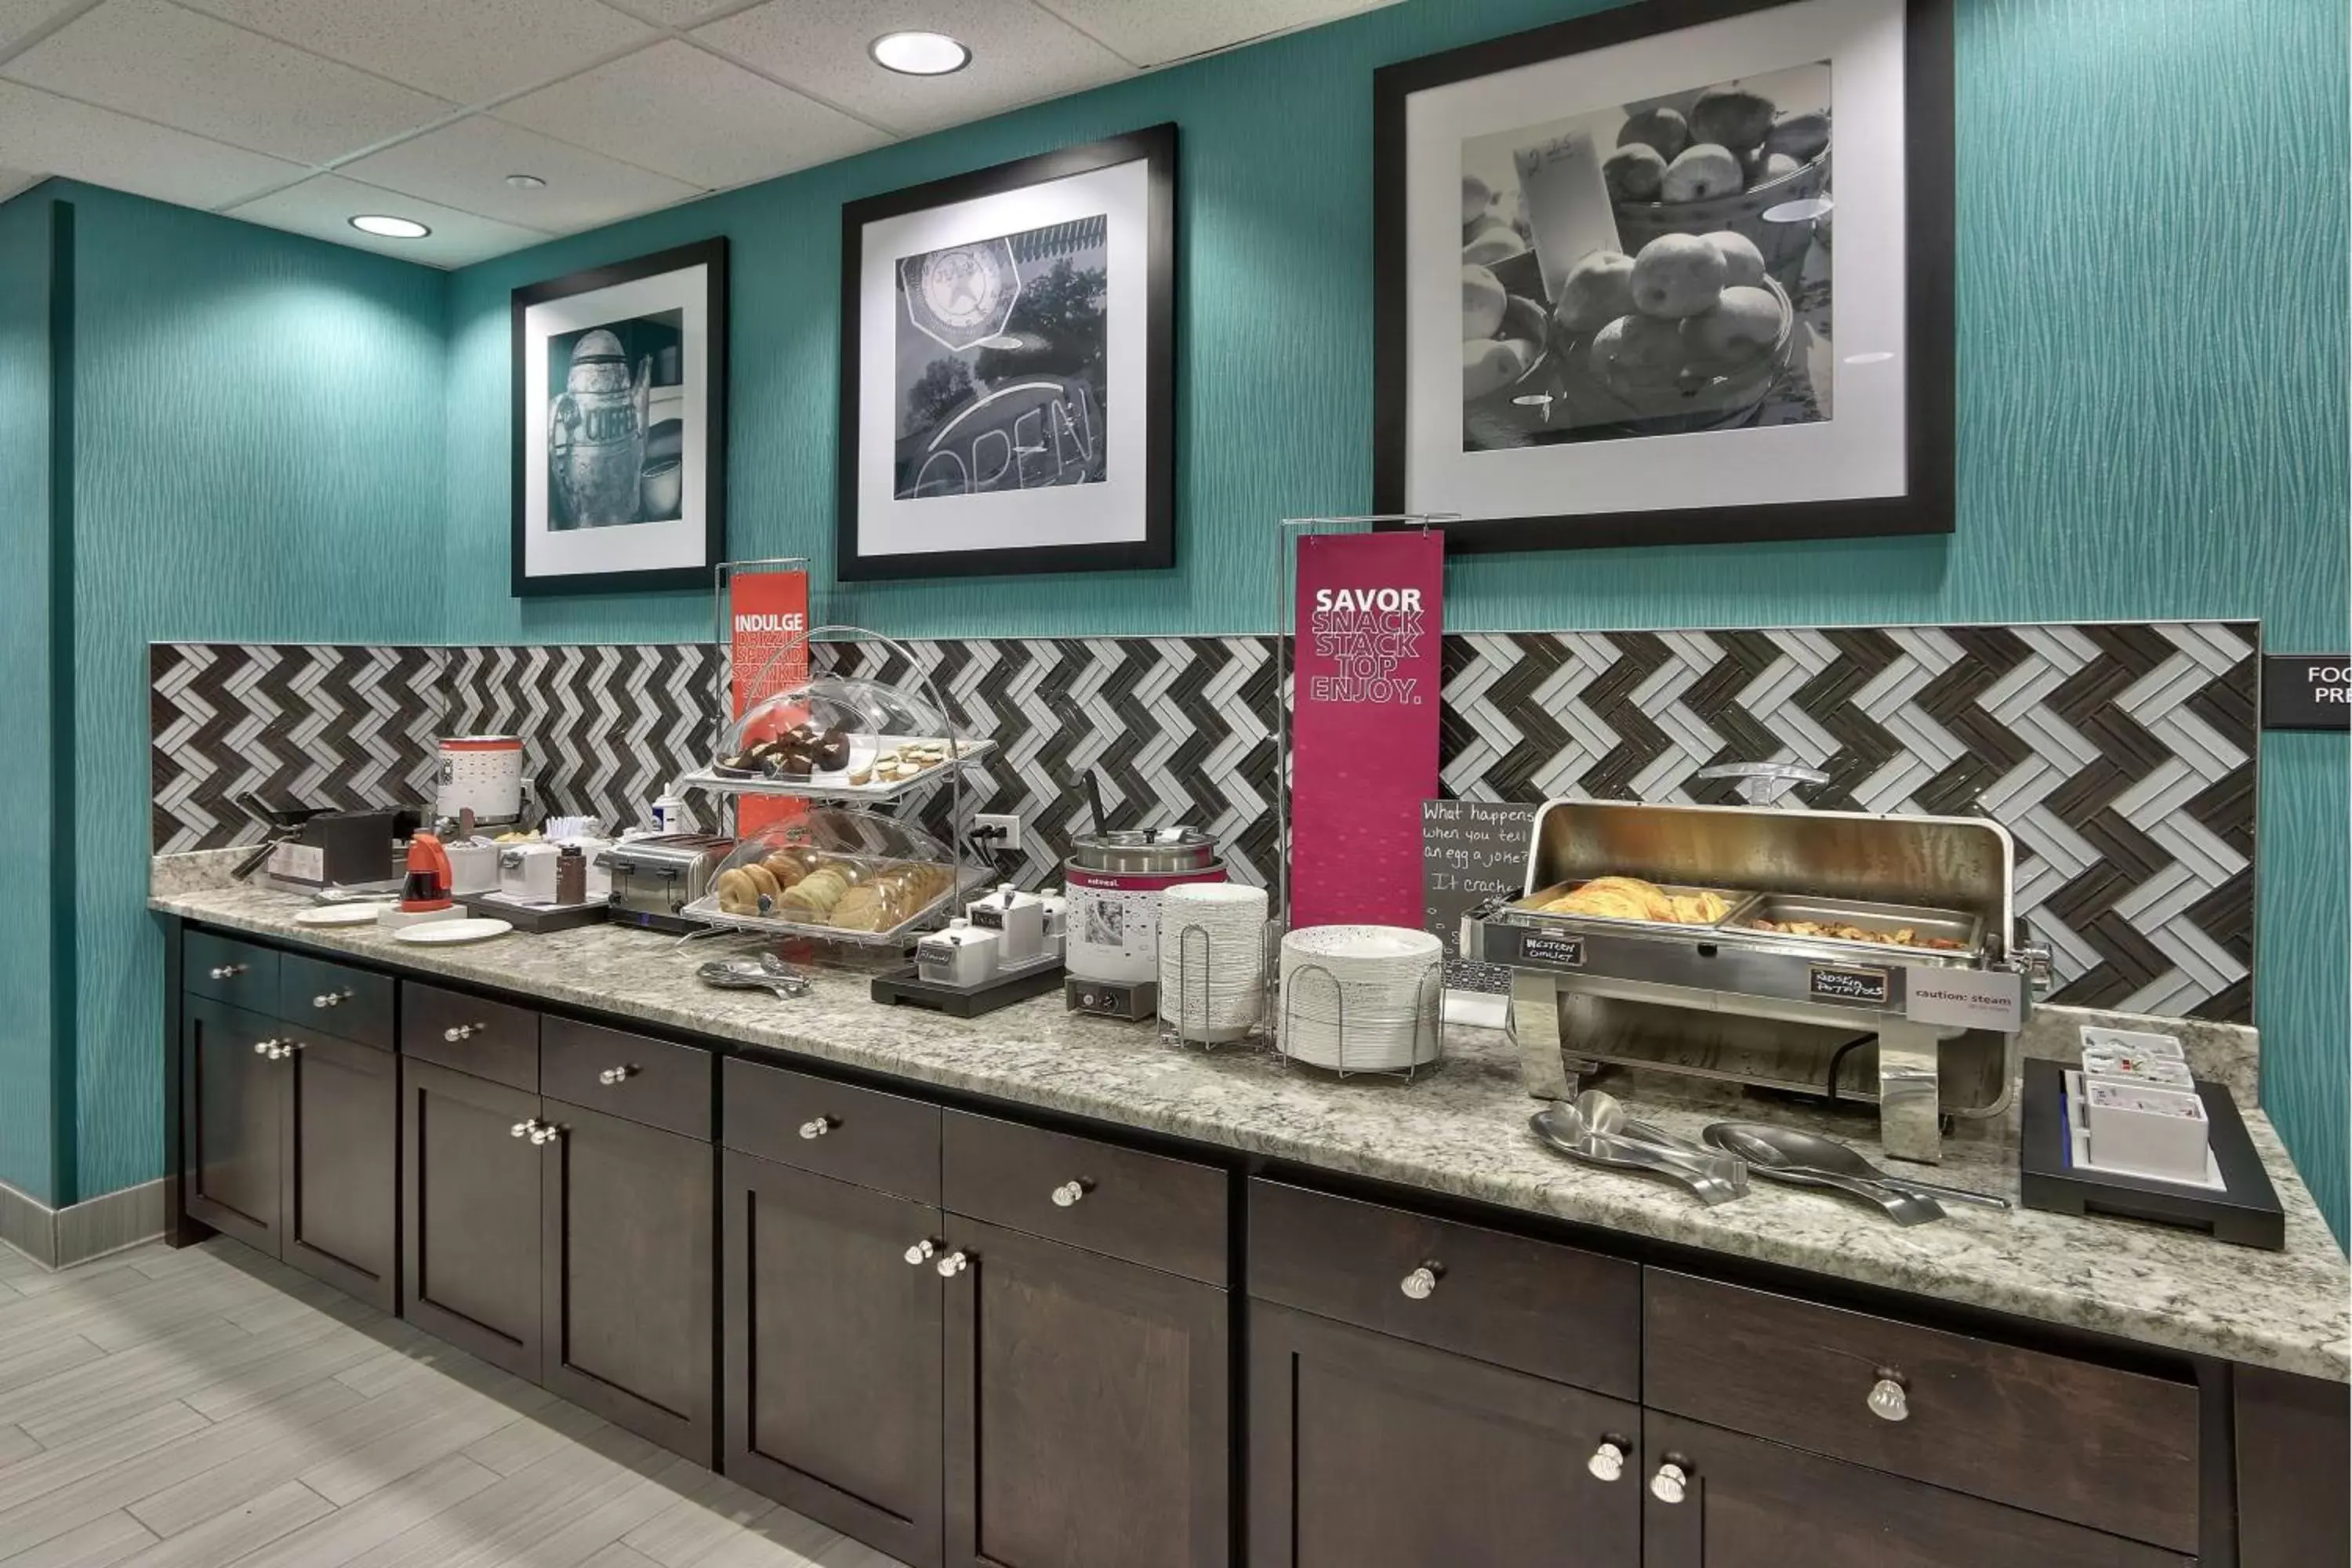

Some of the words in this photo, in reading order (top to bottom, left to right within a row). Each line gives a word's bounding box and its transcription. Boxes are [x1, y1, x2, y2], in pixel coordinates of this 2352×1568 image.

[1316, 589, 1421, 612] SAVOR
[735, 613, 803, 632] INDULGE
[1312, 609, 1425, 635] SNACK
[1316, 632, 1420, 659] STACK
[1334, 654, 1398, 680] TOP
[1311, 675, 1422, 705] ENJOY.
[1423, 803, 1462, 820] What
[1470, 803, 1534, 826] happens
[1423, 827, 1460, 839] when
[1465, 830, 1490, 843] you
[1499, 829, 1526, 842] tell
[1424, 846, 1442, 858] an
[1446, 848, 1468, 869] egg
[1473, 851, 1482, 860] a
[1432, 873, 1458, 890] It
[1915, 989, 1967, 1001] caution:
[1971, 995, 2012, 1004] steam
